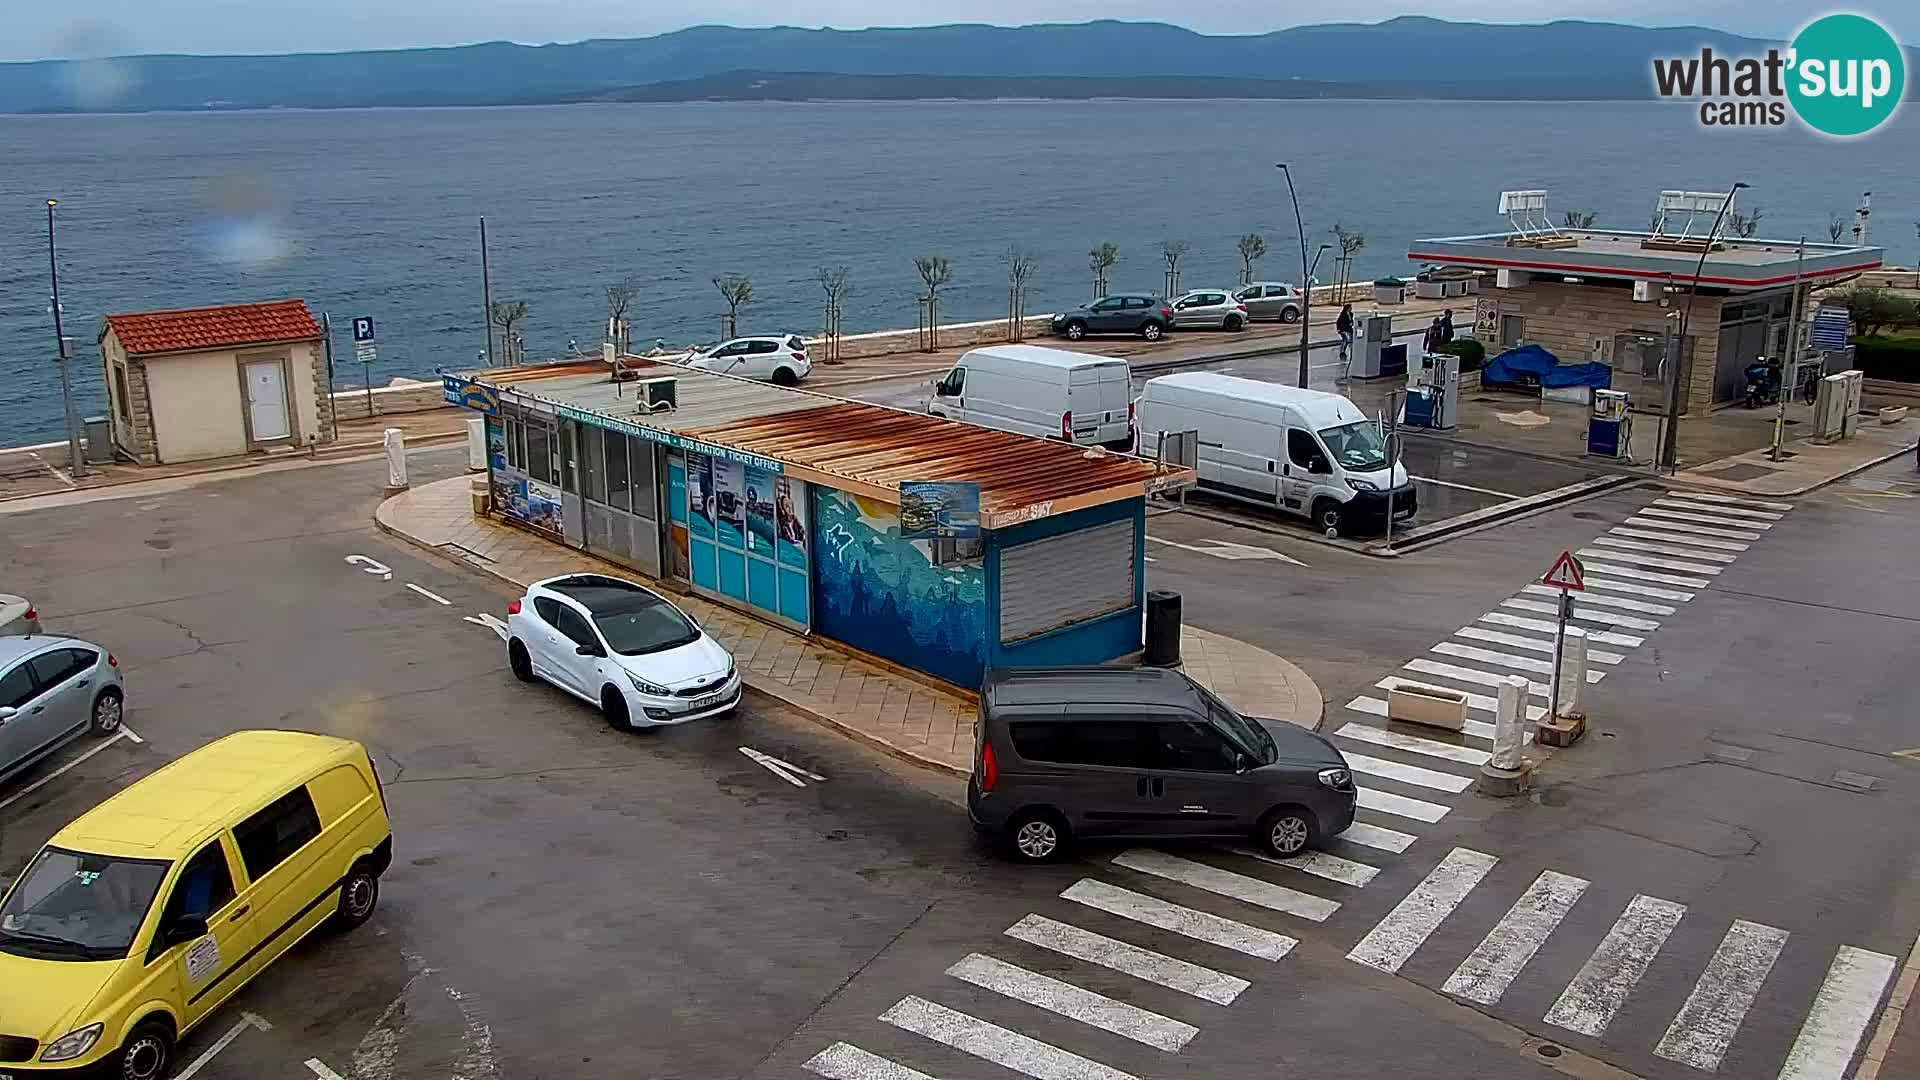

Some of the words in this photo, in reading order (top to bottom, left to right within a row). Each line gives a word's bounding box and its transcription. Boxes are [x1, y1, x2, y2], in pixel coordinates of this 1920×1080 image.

[357, 320, 368, 338] P
[641, 429, 671, 444] POSTAJA
[680, 438, 694, 450] BUS
[695, 443, 726, 458] STATION
[728, 450, 753, 465] TICKET
[754, 457, 780, 471] OFFICE
